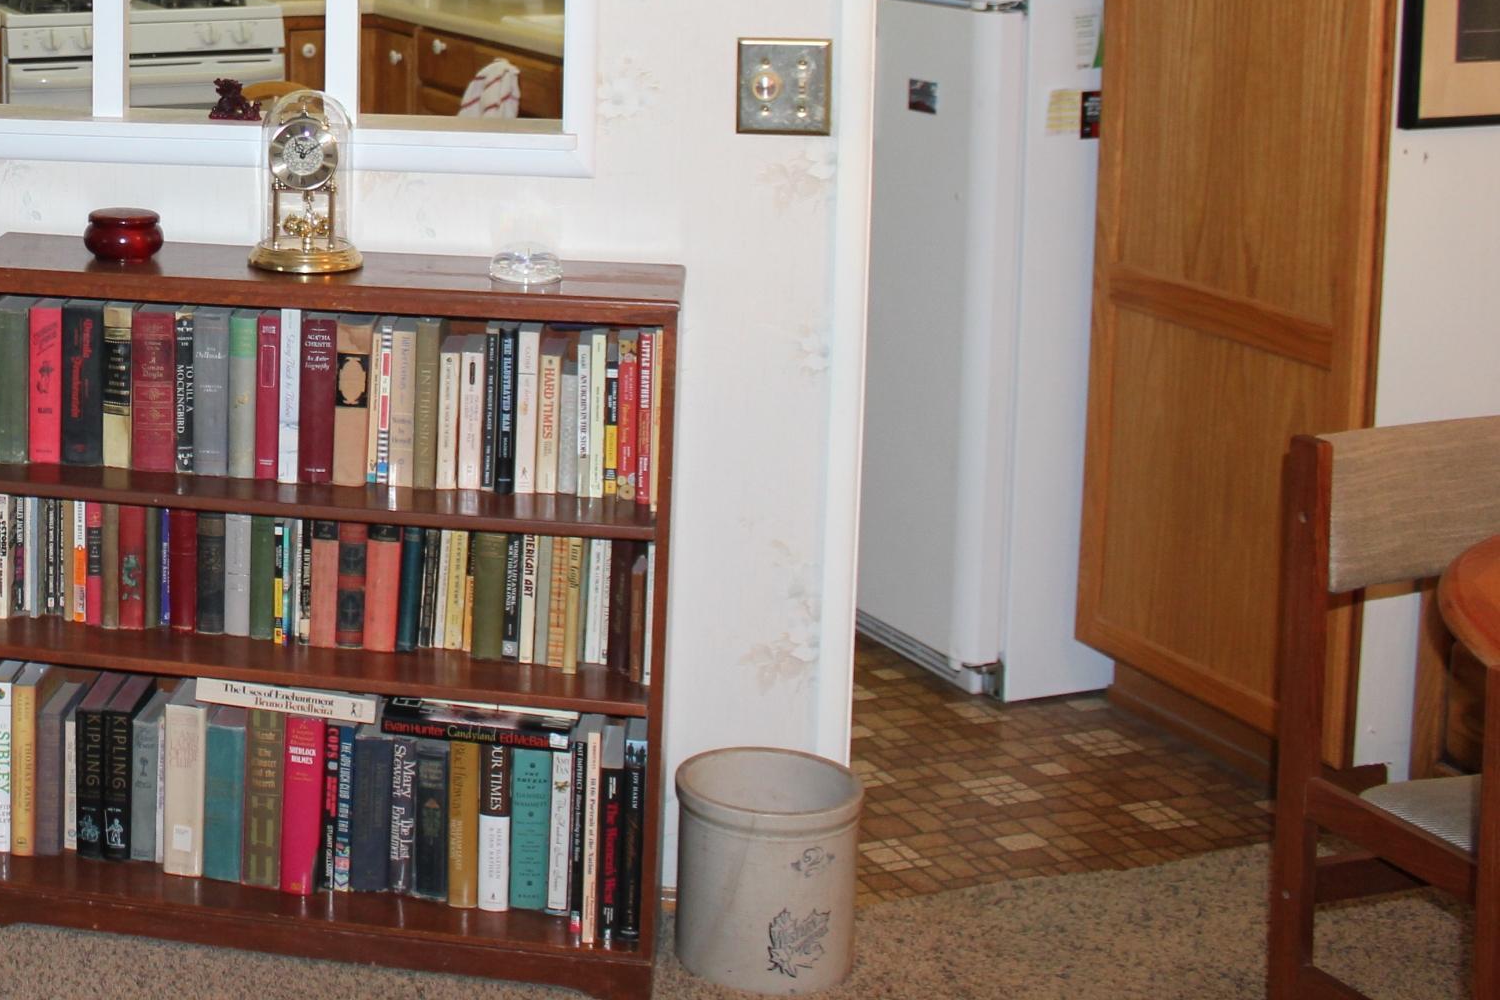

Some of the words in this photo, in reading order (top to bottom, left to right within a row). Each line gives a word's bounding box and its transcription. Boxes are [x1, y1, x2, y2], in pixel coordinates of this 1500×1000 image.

[503, 338, 512, 356] THE
[640, 340, 650, 368] LITTLE
[185, 365, 194, 379] TO
[421, 369, 433, 385] IN
[543, 367, 556, 400] HARD
[580, 374, 588, 384] AN
[186, 382, 194, 401] KILL
[502, 357, 512, 412] ILLUSTRATED
[639, 369, 650, 410] HEATHENS
[177, 364, 185, 434] MOCKINGBIRD
[185, 405, 194, 413] A
[501, 413, 511, 432] MAN
[542, 401, 555, 440] TIMES
[580, 411, 588, 420] IN
[579, 421, 588, 434] THE
[419, 424, 430, 457] SIGN
[579, 435, 588, 459] STORM
[455, 534, 463, 573] OLIVER
[524, 534, 536, 576] MERICAN
[571, 544, 581, 561] Van
[523, 579, 534, 599] ART
[568, 565, 578, 590] Gogh
[222, 682, 240, 694] The
[242, 684, 262, 696] Uses
[262, 686, 274, 698] of
[273, 688, 334, 706] Enchantment
[254, 697, 284, 709] Bruno
[327, 728, 339, 759] COPS
[340, 741, 352, 754] THE
[446, 725, 497, 742] Candyland
[514, 736, 550, 748] McBai
[87, 713, 101, 787] KIPLING
[112, 715, 126, 791] KIPLING
[289, 746, 317, 757] SHERLOCK
[291, 755, 314, 765] HOLMES
[340, 754, 352, 767] JOY
[491, 744, 504, 770] OUR
[340, 767, 351, 782] LUCK
[392, 744, 407, 798] Stewart
[401, 760, 416, 798] Mary
[339, 783, 351, 799] CLUB
[489, 771, 503, 811] TIMES
[631, 786, 639, 809] HAKIM
[605, 802, 619, 825] The
[338, 820, 349, 833] TAN
[389, 804, 404, 862] Enchantment
[400, 817, 415, 836] The
[399, 839, 414, 860] Last
[603, 827, 618, 876] Women's
[602, 877, 616, 904] West
